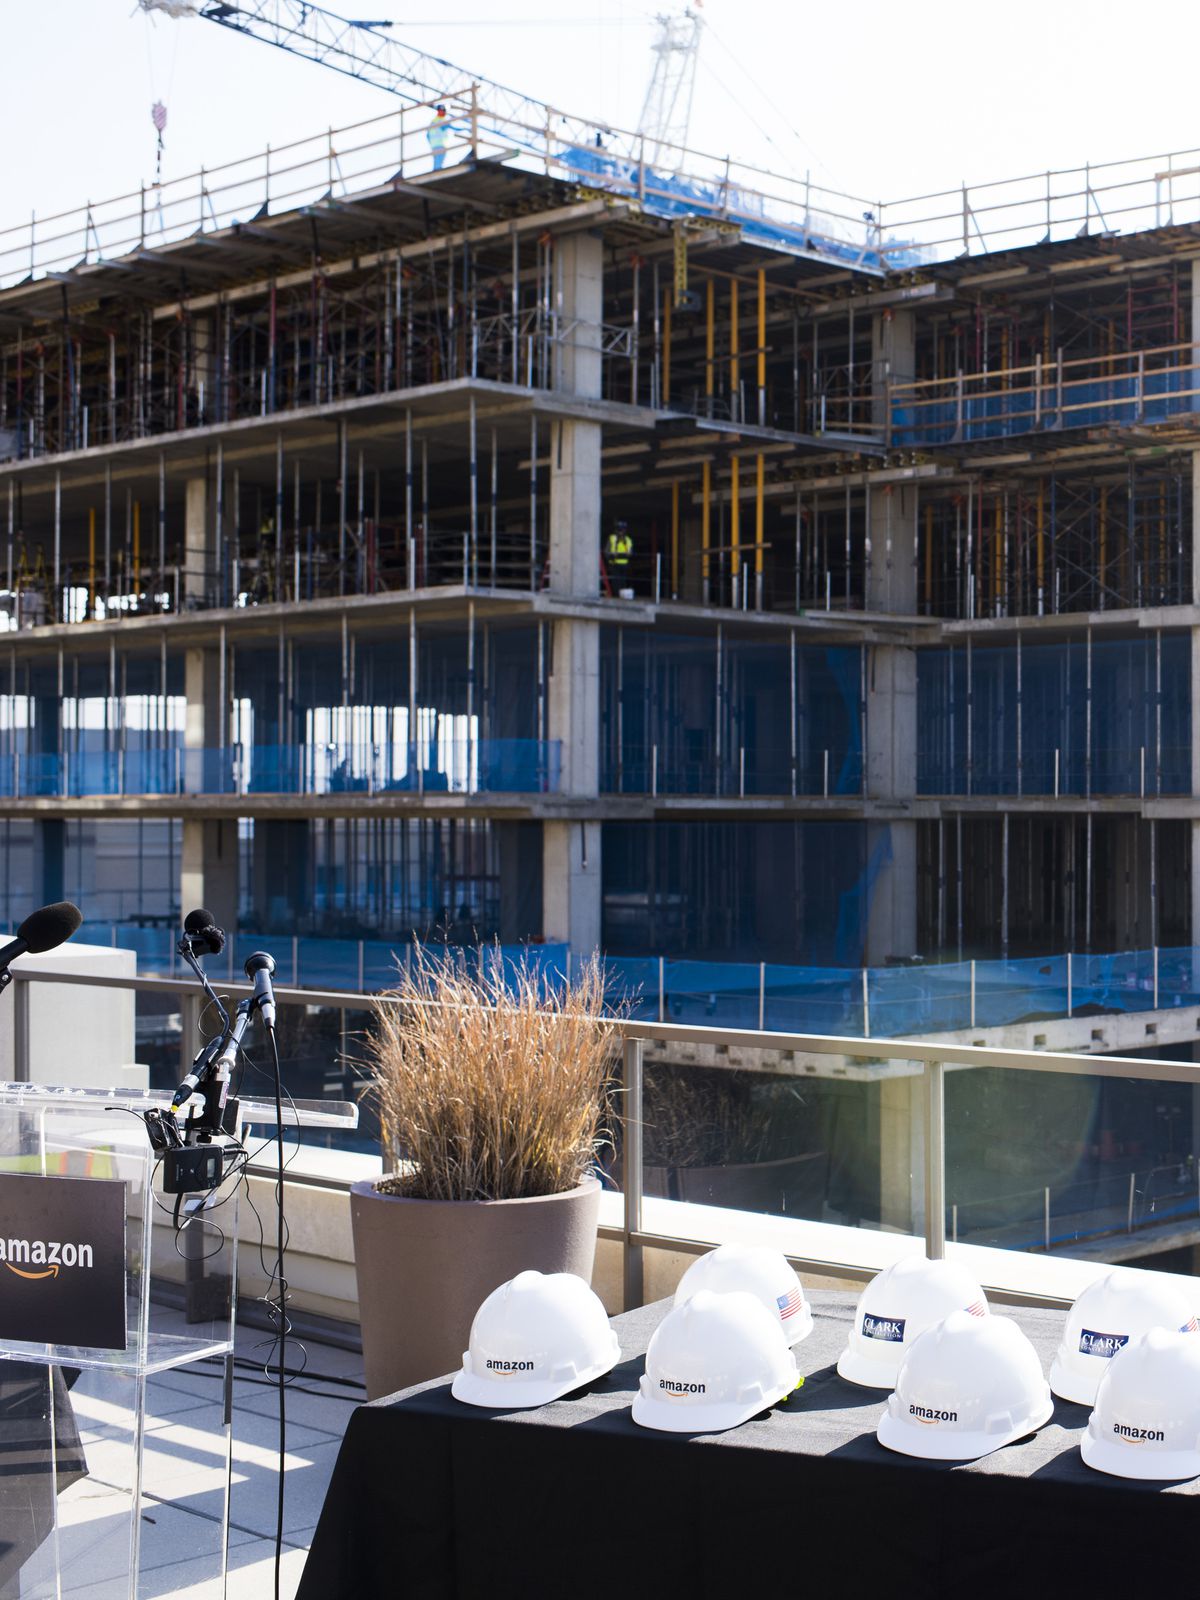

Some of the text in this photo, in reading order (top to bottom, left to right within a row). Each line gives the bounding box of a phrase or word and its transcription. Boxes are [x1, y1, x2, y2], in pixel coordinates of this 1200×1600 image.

[864, 1317, 903, 1333] CLARK
[1082, 1333, 1124, 1350] CLARK
[487, 1359, 534, 1371] amazon
[659, 1379, 706, 1393] amazon
[909, 1404, 958, 1421] amazon
[1113, 1423, 1165, 1441] amazon
